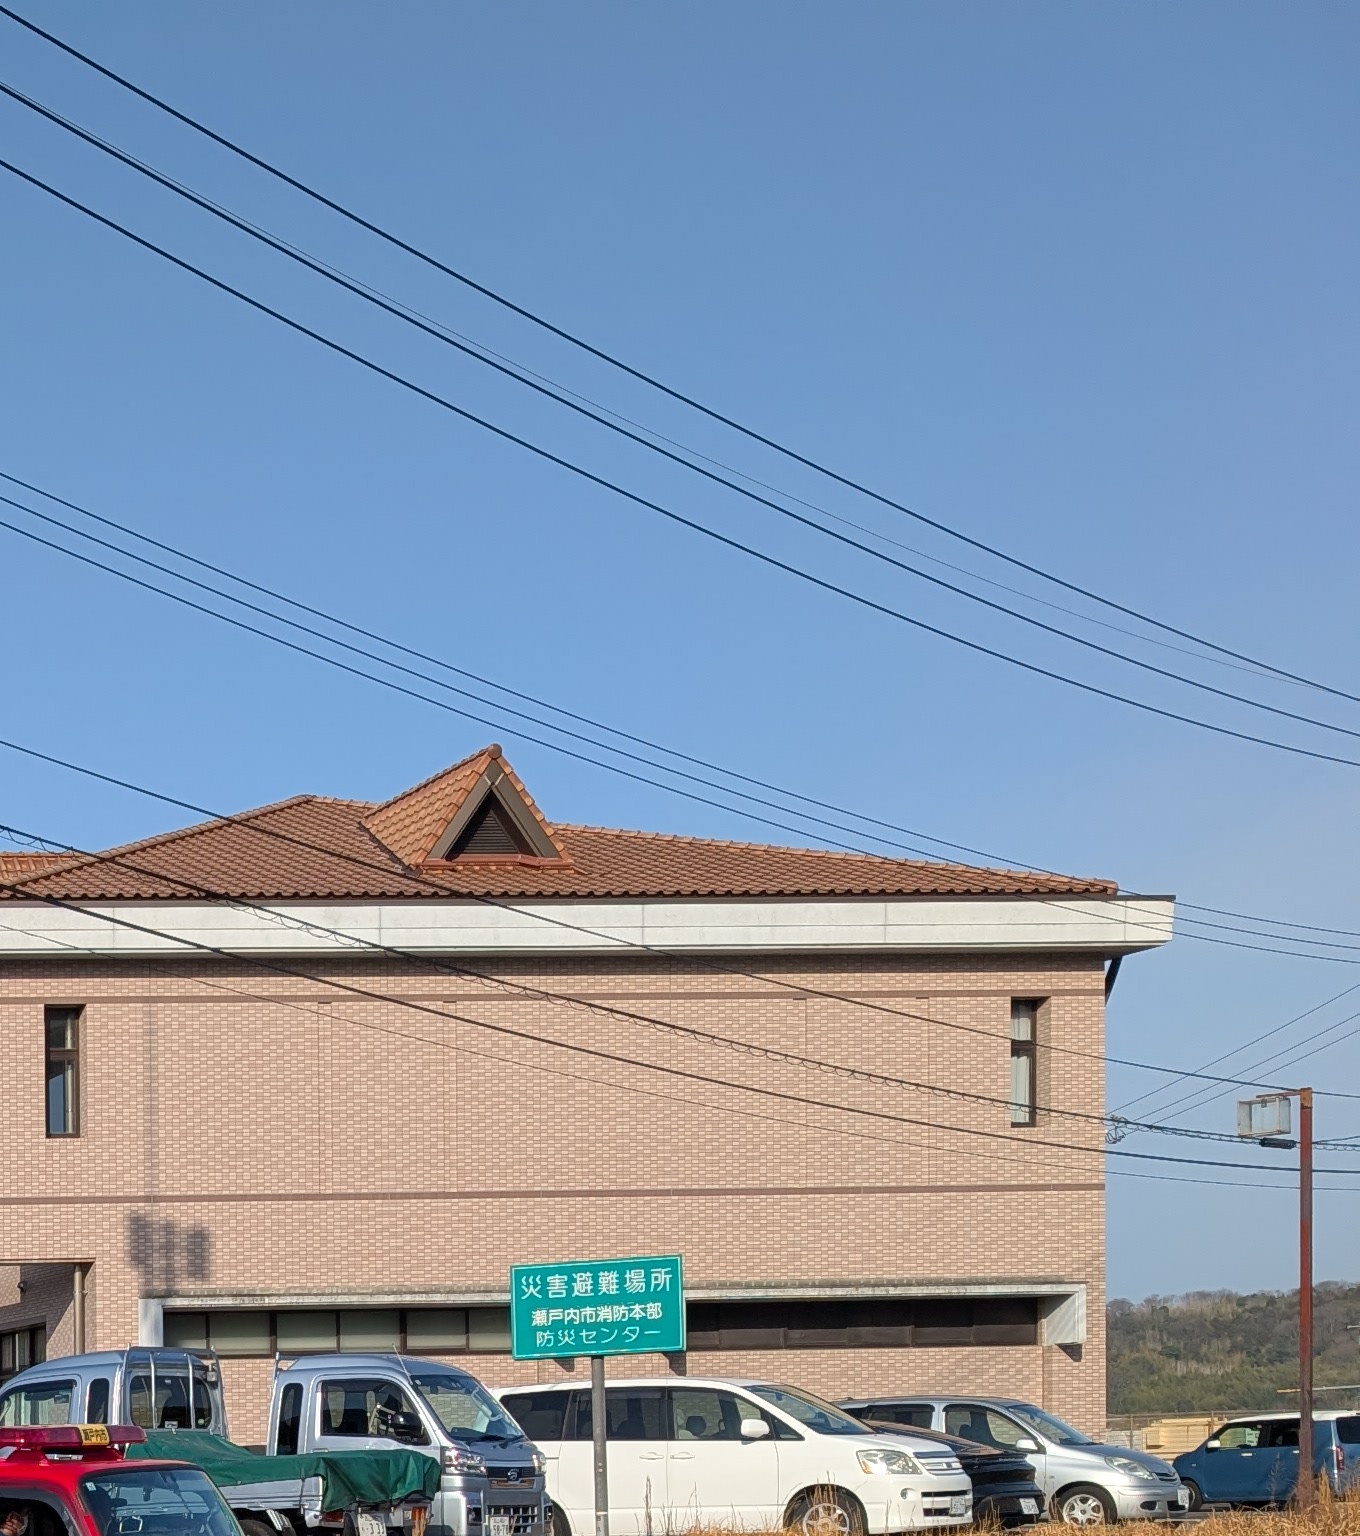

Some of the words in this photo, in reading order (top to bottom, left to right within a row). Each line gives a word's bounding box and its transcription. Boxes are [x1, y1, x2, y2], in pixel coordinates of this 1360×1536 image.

[521, 1267, 673, 1299] 災害避難場所
[531, 1303, 662, 1326] 瀬戸内市消防本部
[536, 1326, 661, 1347] 防災センター
